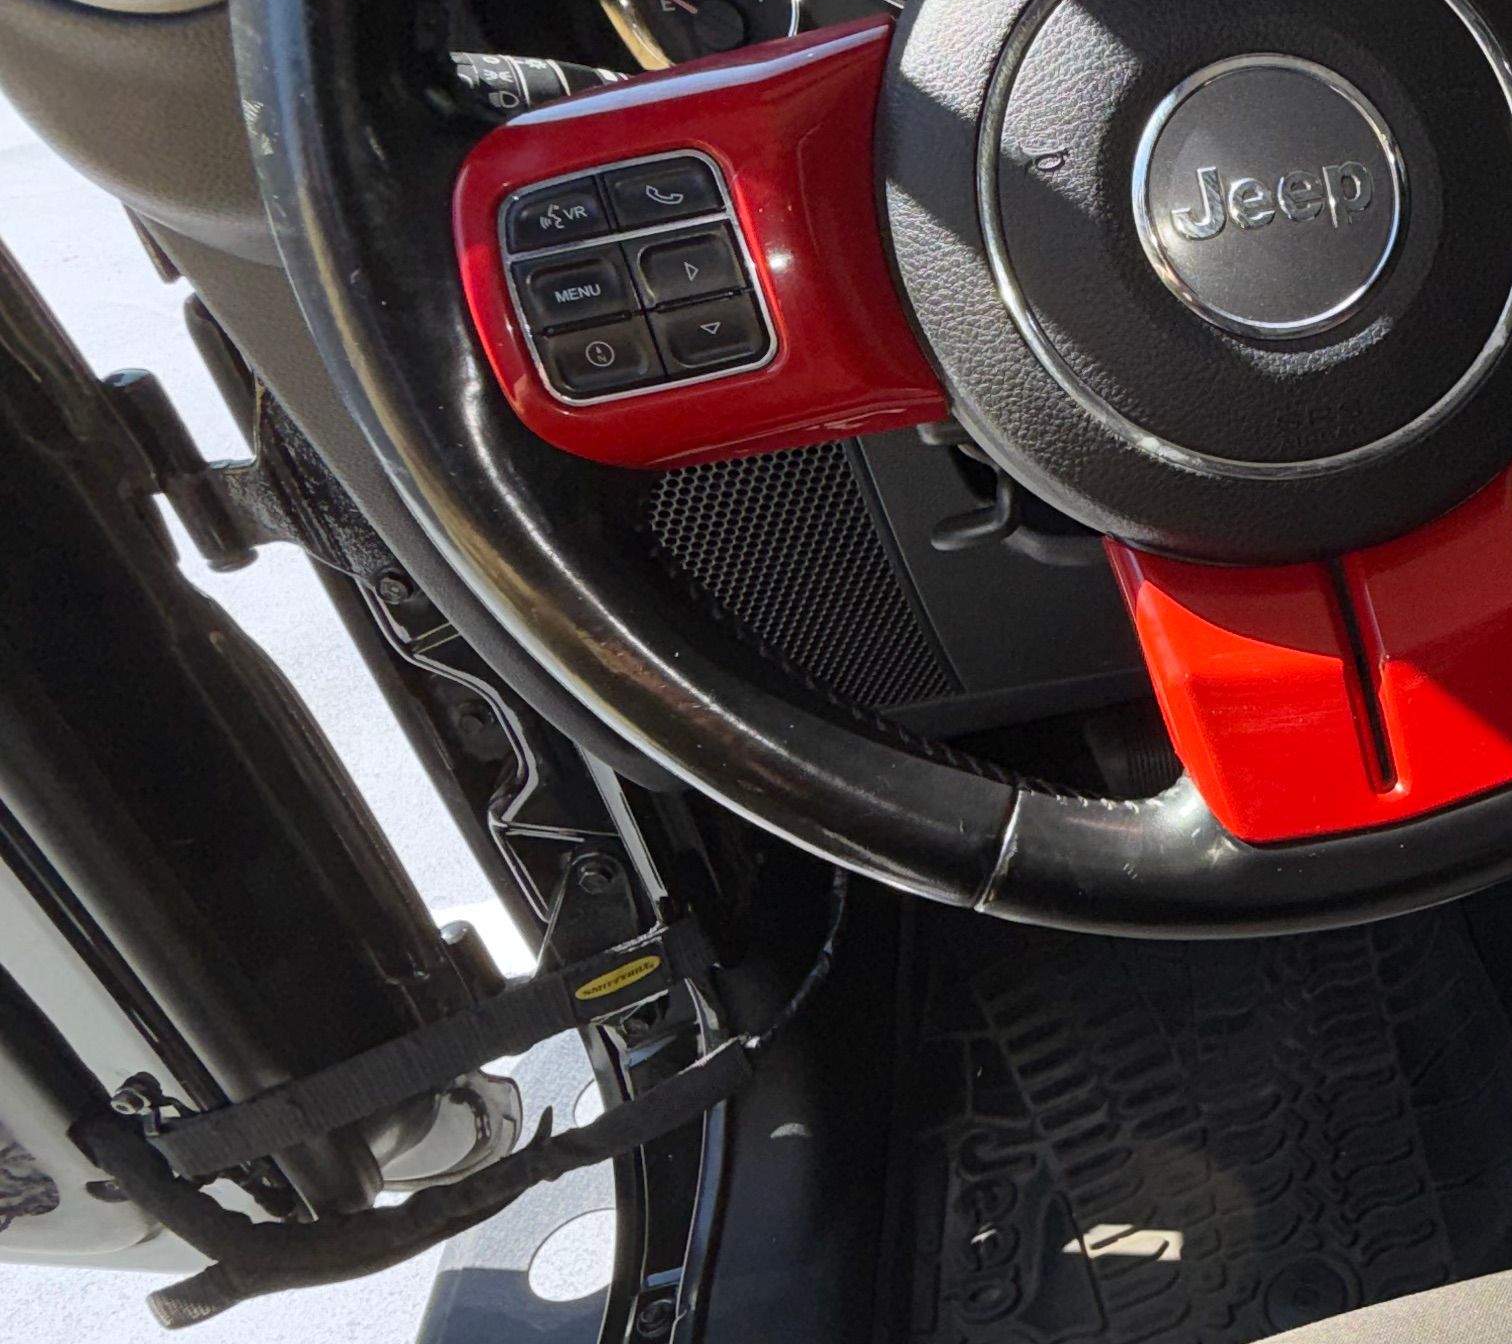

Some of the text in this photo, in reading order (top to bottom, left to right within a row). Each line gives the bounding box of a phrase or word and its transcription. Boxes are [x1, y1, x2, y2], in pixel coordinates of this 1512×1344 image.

[563, 204, 588, 221] VR
[1170, 160, 1375, 241] Jeep
[555, 283, 602, 304] MENU
[952, 1129, 1038, 1326] Jeep
